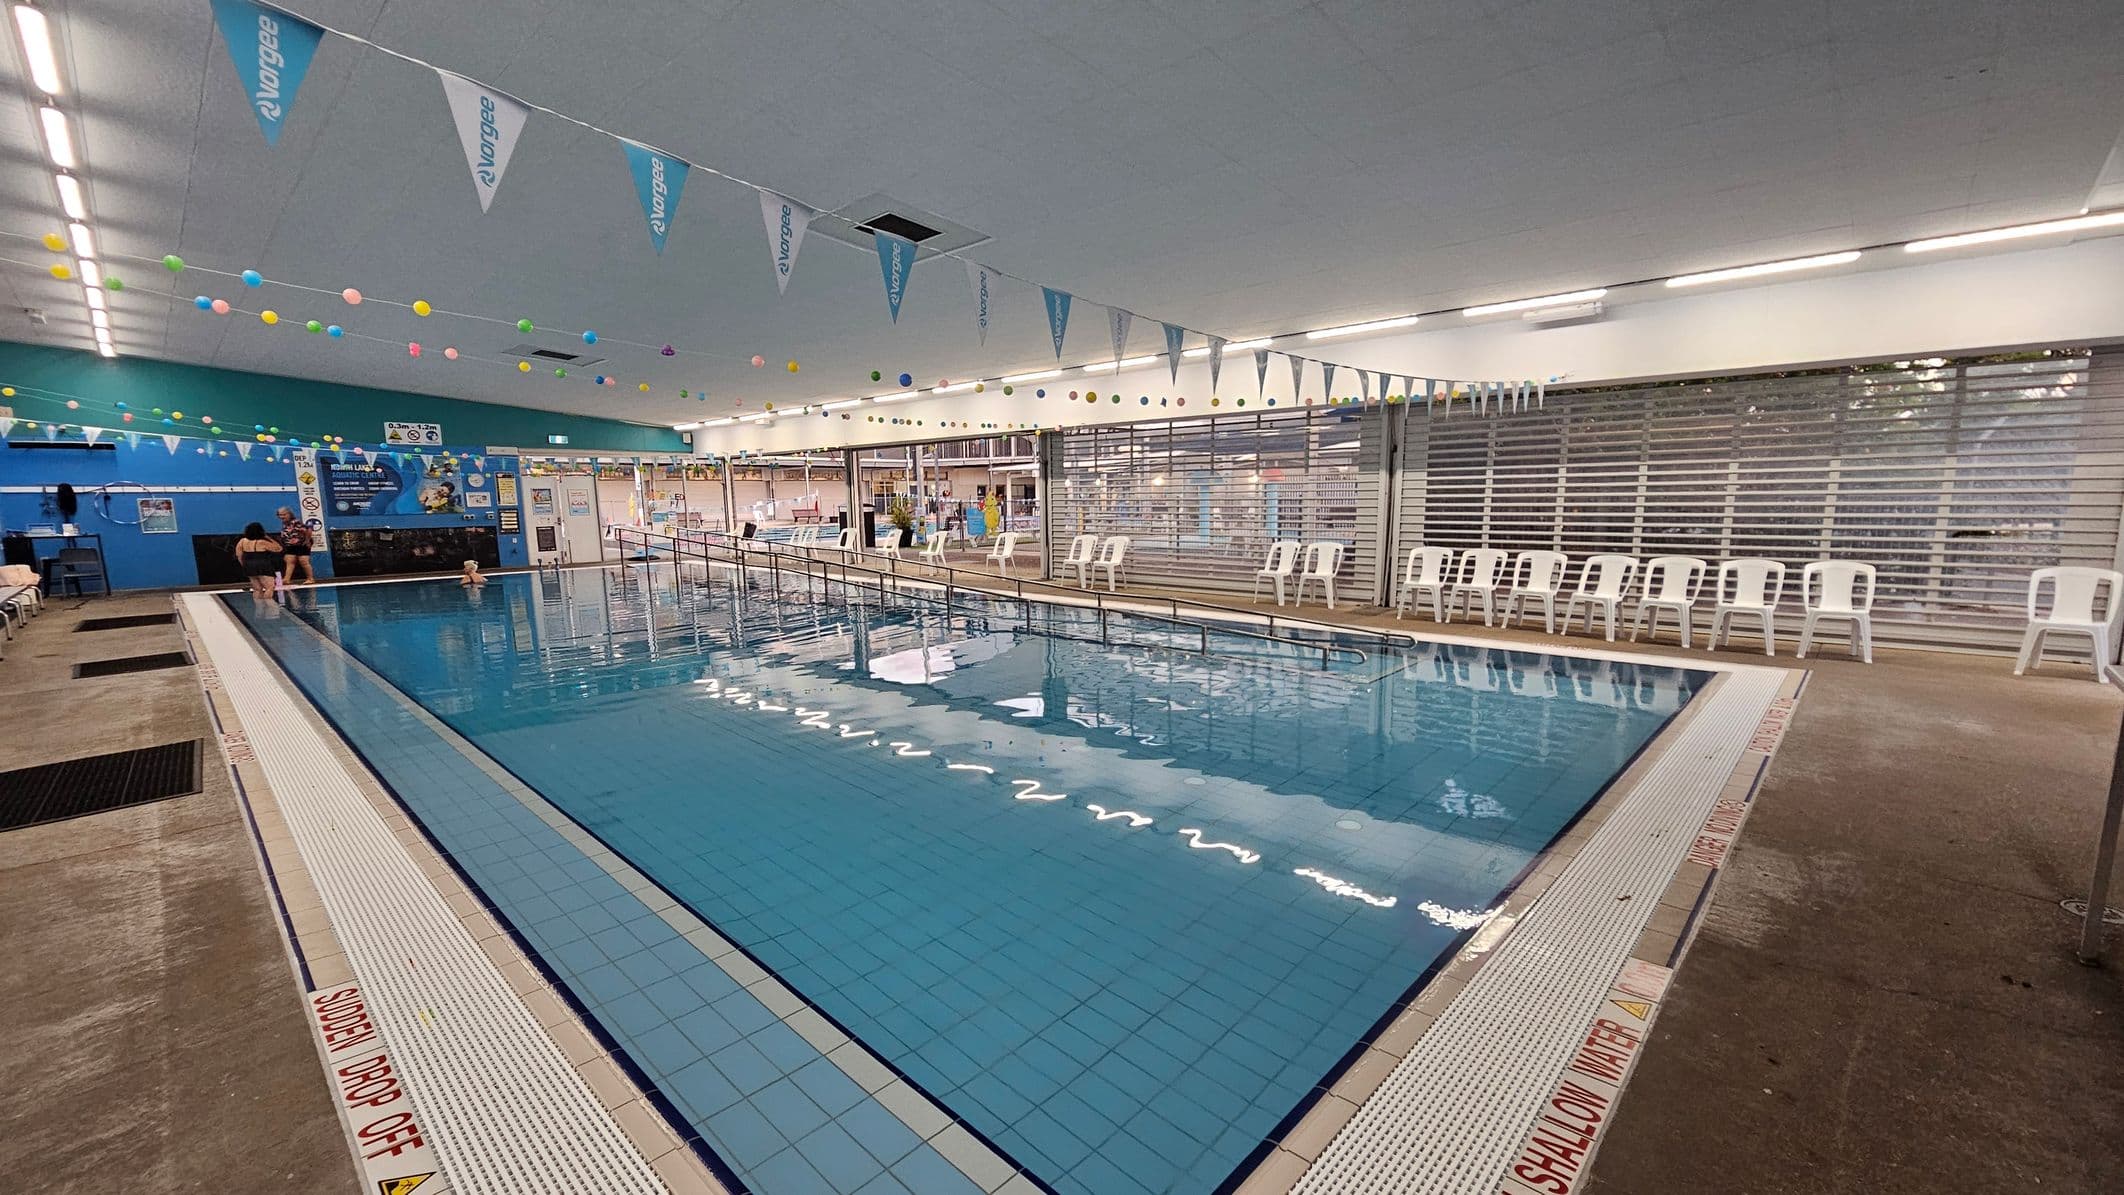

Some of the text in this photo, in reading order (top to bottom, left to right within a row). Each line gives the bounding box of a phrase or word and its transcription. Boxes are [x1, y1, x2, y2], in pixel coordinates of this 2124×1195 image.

[256, 15, 285, 99] vorgee
[477, 95, 500, 167] vorgee
[650, 157, 668, 220] vorgee
[778, 204, 792, 263] vorgee
[890, 242, 901, 295] vorgee
[978, 271, 988, 319] vorgee
[313, 988, 425, 1161] SUDDEN DROP OFF
[1513, 1018, 1641, 1195] SHALLOW WATER
